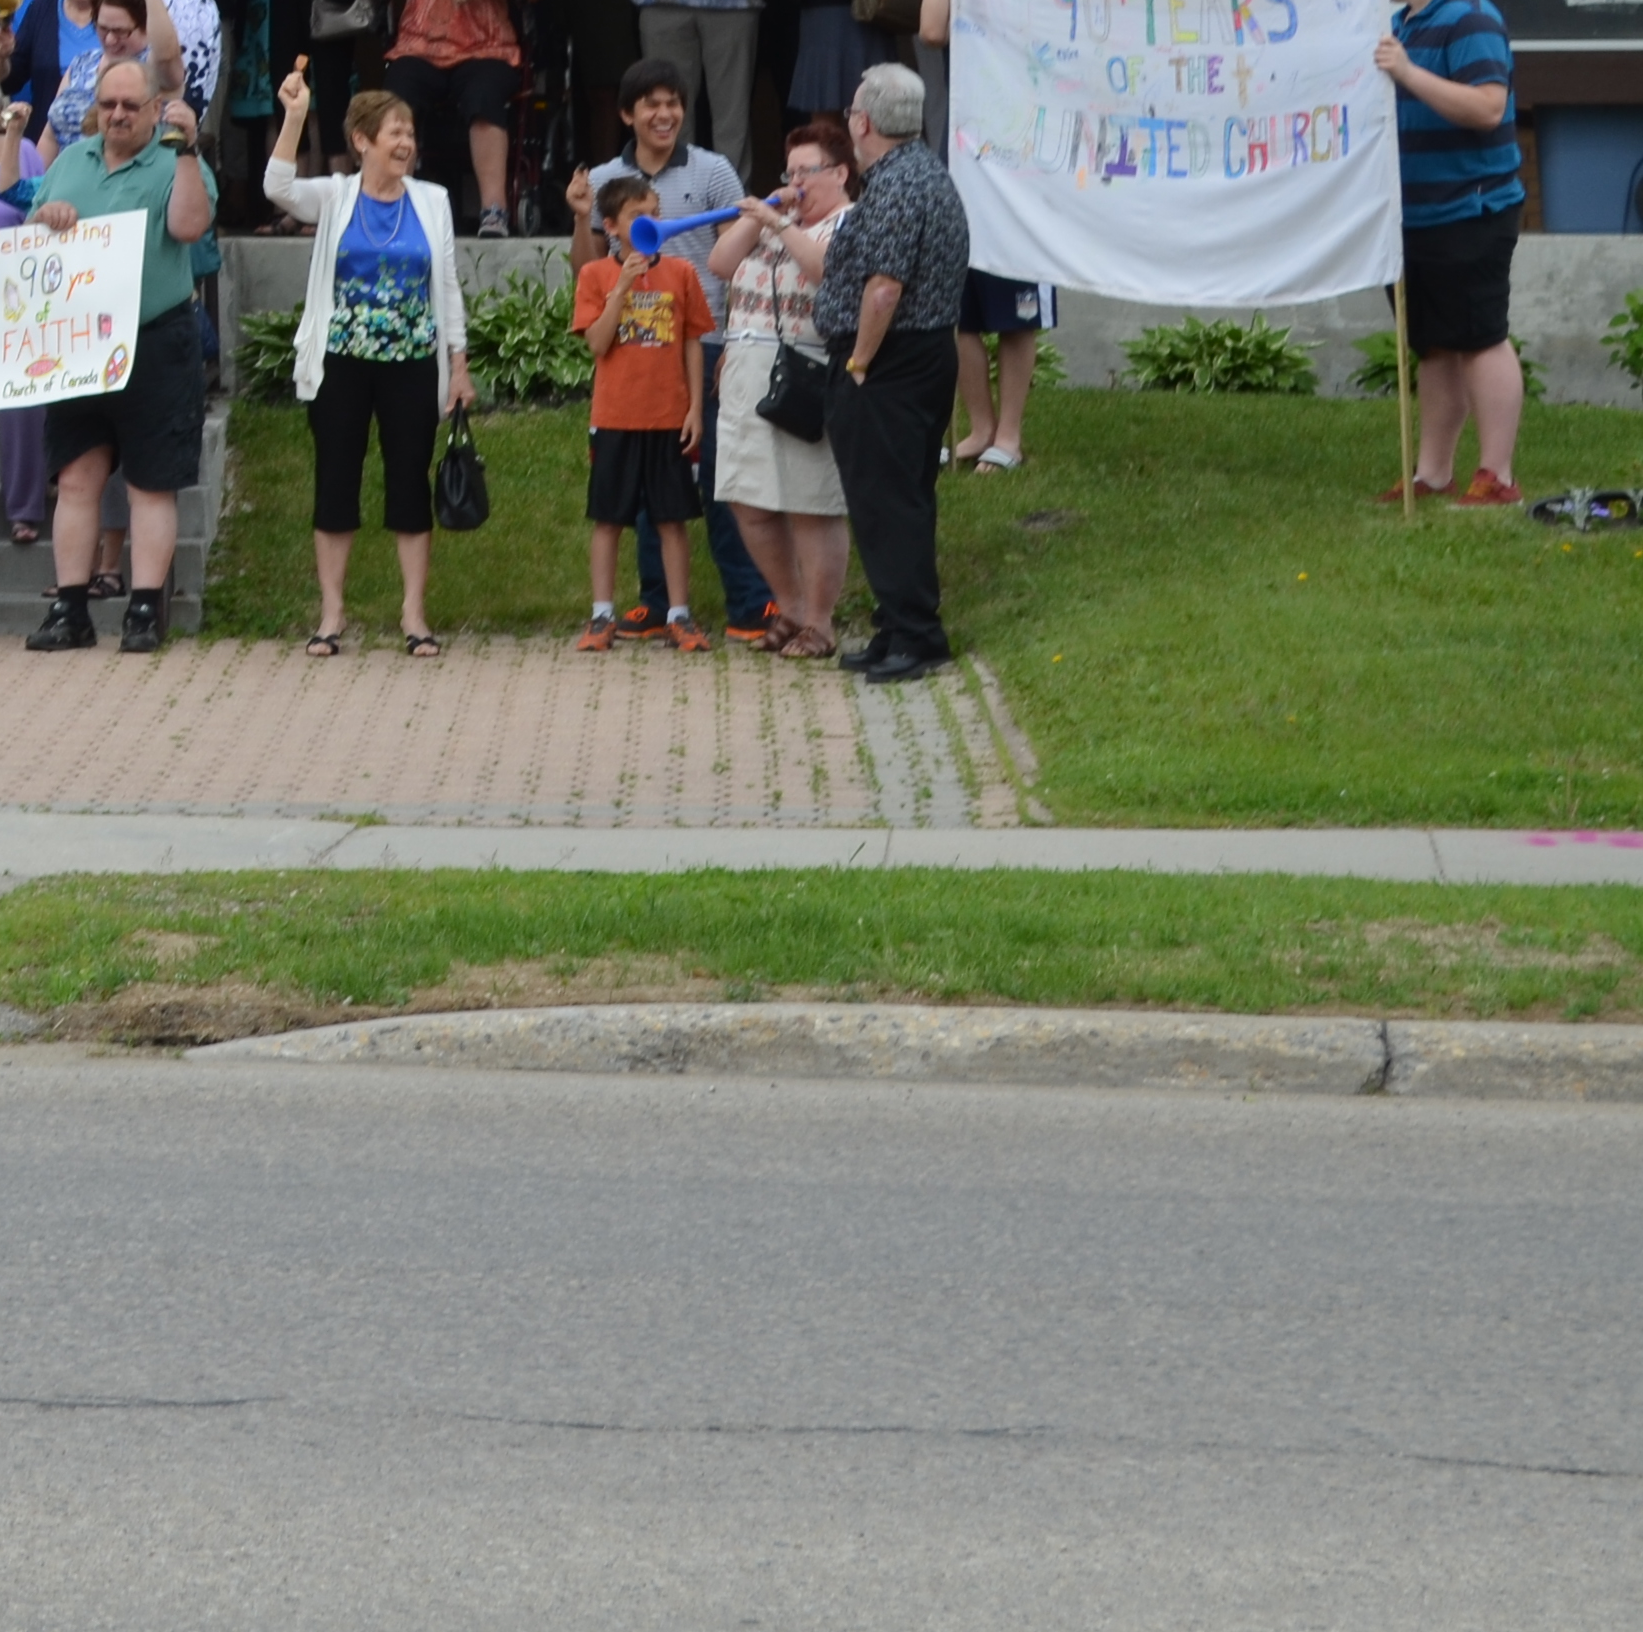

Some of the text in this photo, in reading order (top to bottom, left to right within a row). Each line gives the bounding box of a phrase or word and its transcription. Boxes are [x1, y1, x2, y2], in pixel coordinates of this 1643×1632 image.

[1105, 54, 1226, 96] OF THE
[1031, 103, 1350, 180] UNITED CHURCH
[20, 254, 95, 303] 90 yrs
[35, 299, 51, 323] of
[2, 312, 91, 364] FAITH
[3, 378, 37, 399] Church
[60, 368, 98, 390] Canada
